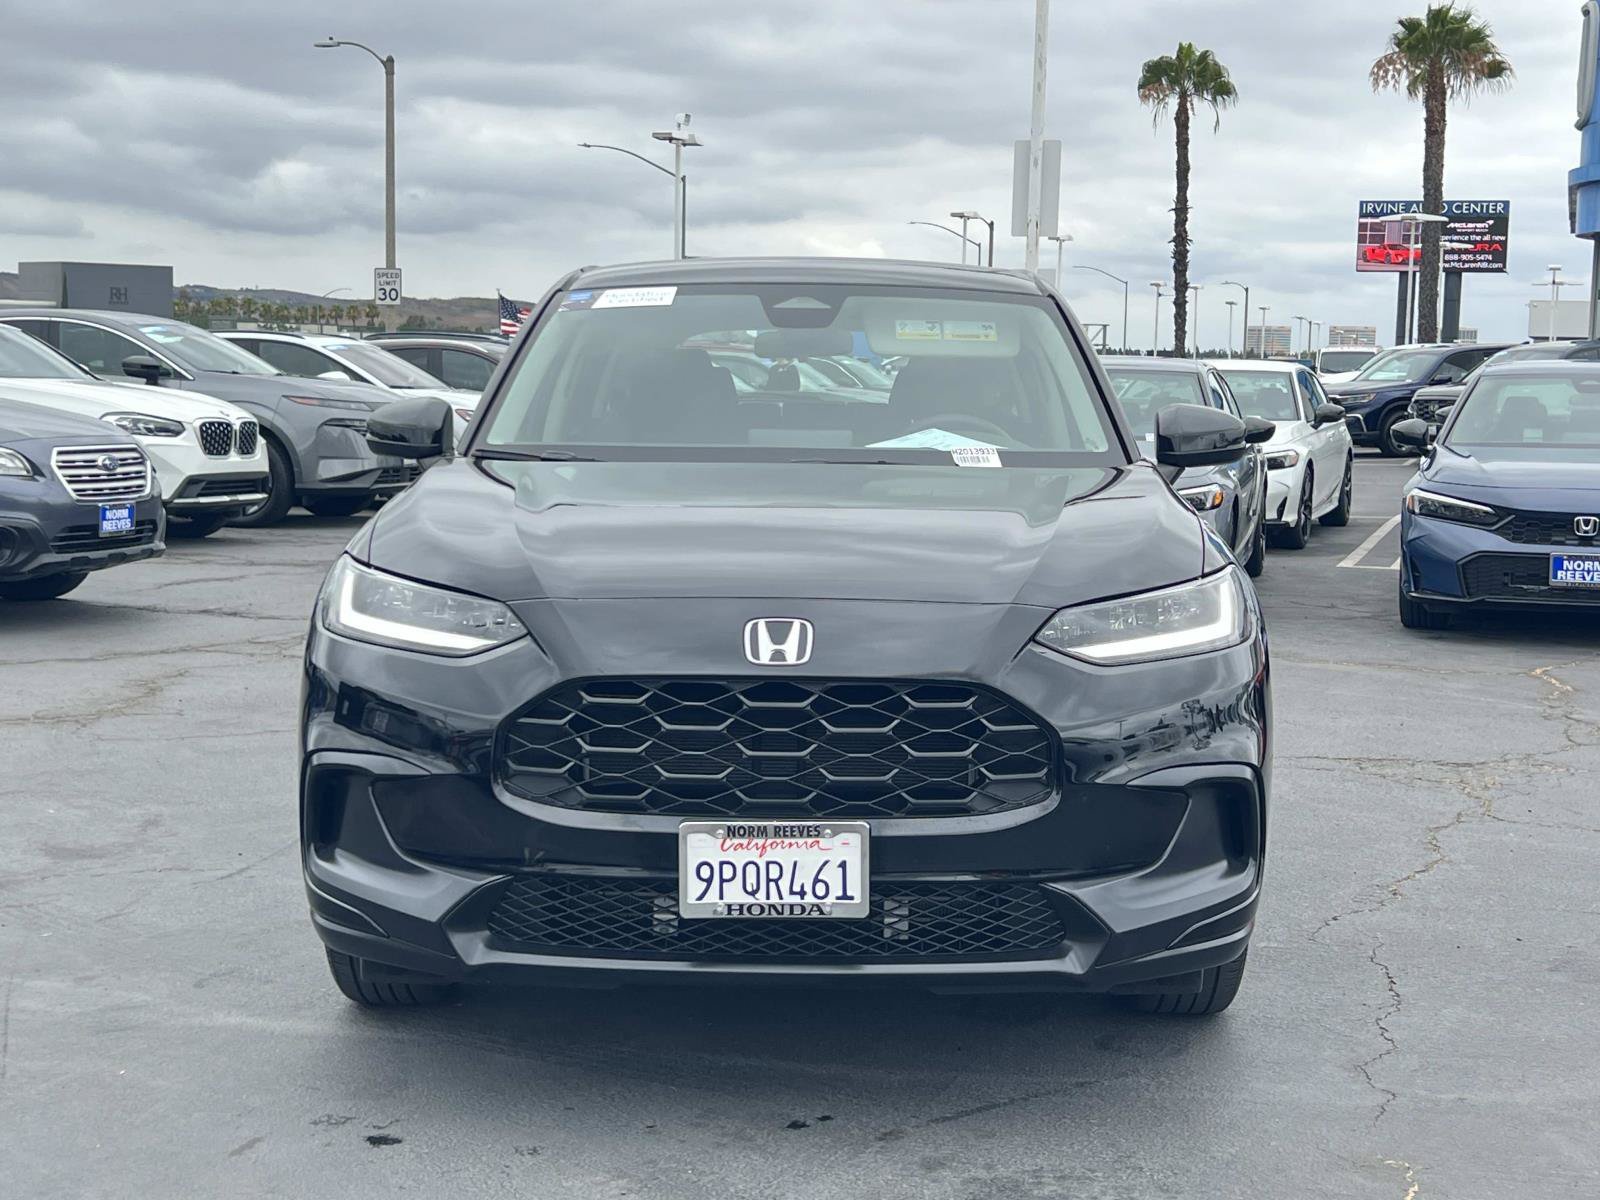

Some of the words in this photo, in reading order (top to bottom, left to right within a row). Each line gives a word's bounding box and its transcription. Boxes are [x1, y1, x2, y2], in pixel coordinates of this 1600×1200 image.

[1362, 202, 1405, 214] IRVINE
[1452, 202, 1504, 214] CENTER
[1482, 233, 1491, 241] all
[110, 286, 128, 301] RH
[378, 287, 399, 302] 30
[105, 508, 129, 520] NORM
[102, 518, 132, 531] REEVES
[1557, 570, 1600, 582] REEVE
[726, 825, 768, 838] NORM
[773, 825, 821, 838] REEVES
[720, 837, 833, 858] California
[695, 859, 855, 901] 9PQR461
[726, 903, 826, 916] HONDA
